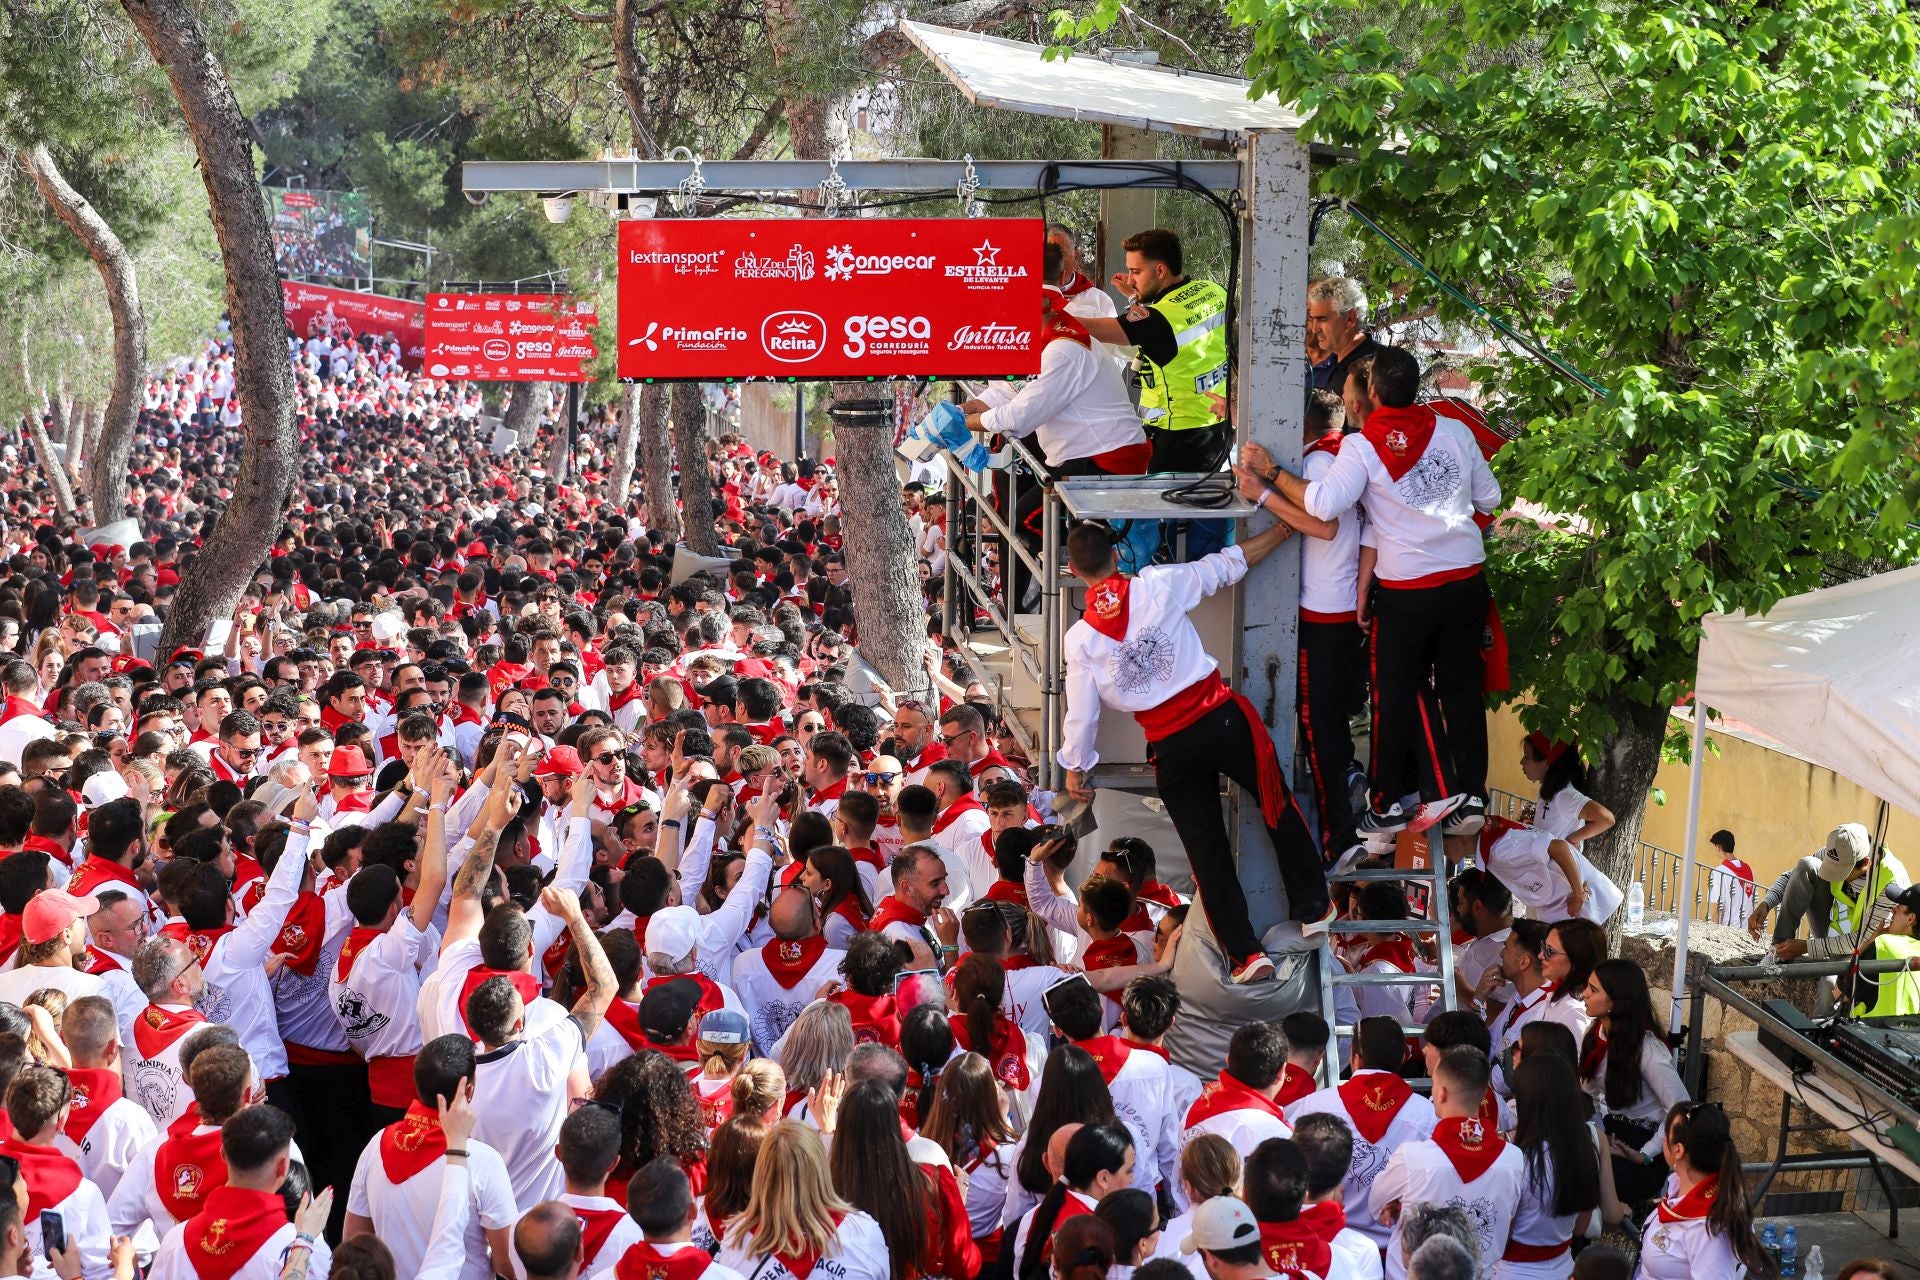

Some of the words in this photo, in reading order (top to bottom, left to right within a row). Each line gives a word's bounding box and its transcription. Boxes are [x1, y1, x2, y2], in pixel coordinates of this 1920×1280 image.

[735, 258, 771, 269] CRUZ
[837, 252, 936, 274] Congecar
[735, 269, 794, 278] PEREGRINO
[944, 265, 1028, 277] ESTRELLA
[662, 327, 748, 341] PrimaFrio
[843, 315, 931, 358] gesa
[947, 321, 1031, 350] Intusa
[516, 341, 553, 359] gesa
[676, 340, 726, 349] Fundación
[770, 336, 816, 350] Reina
[869, 340, 929, 349] CORREDURÍA
[137, 1060, 172, 1075] MINIPUA
[1363, 1093, 1395, 1111] TERREMOTO
[200, 1236, 235, 1255] TERREMOTO
